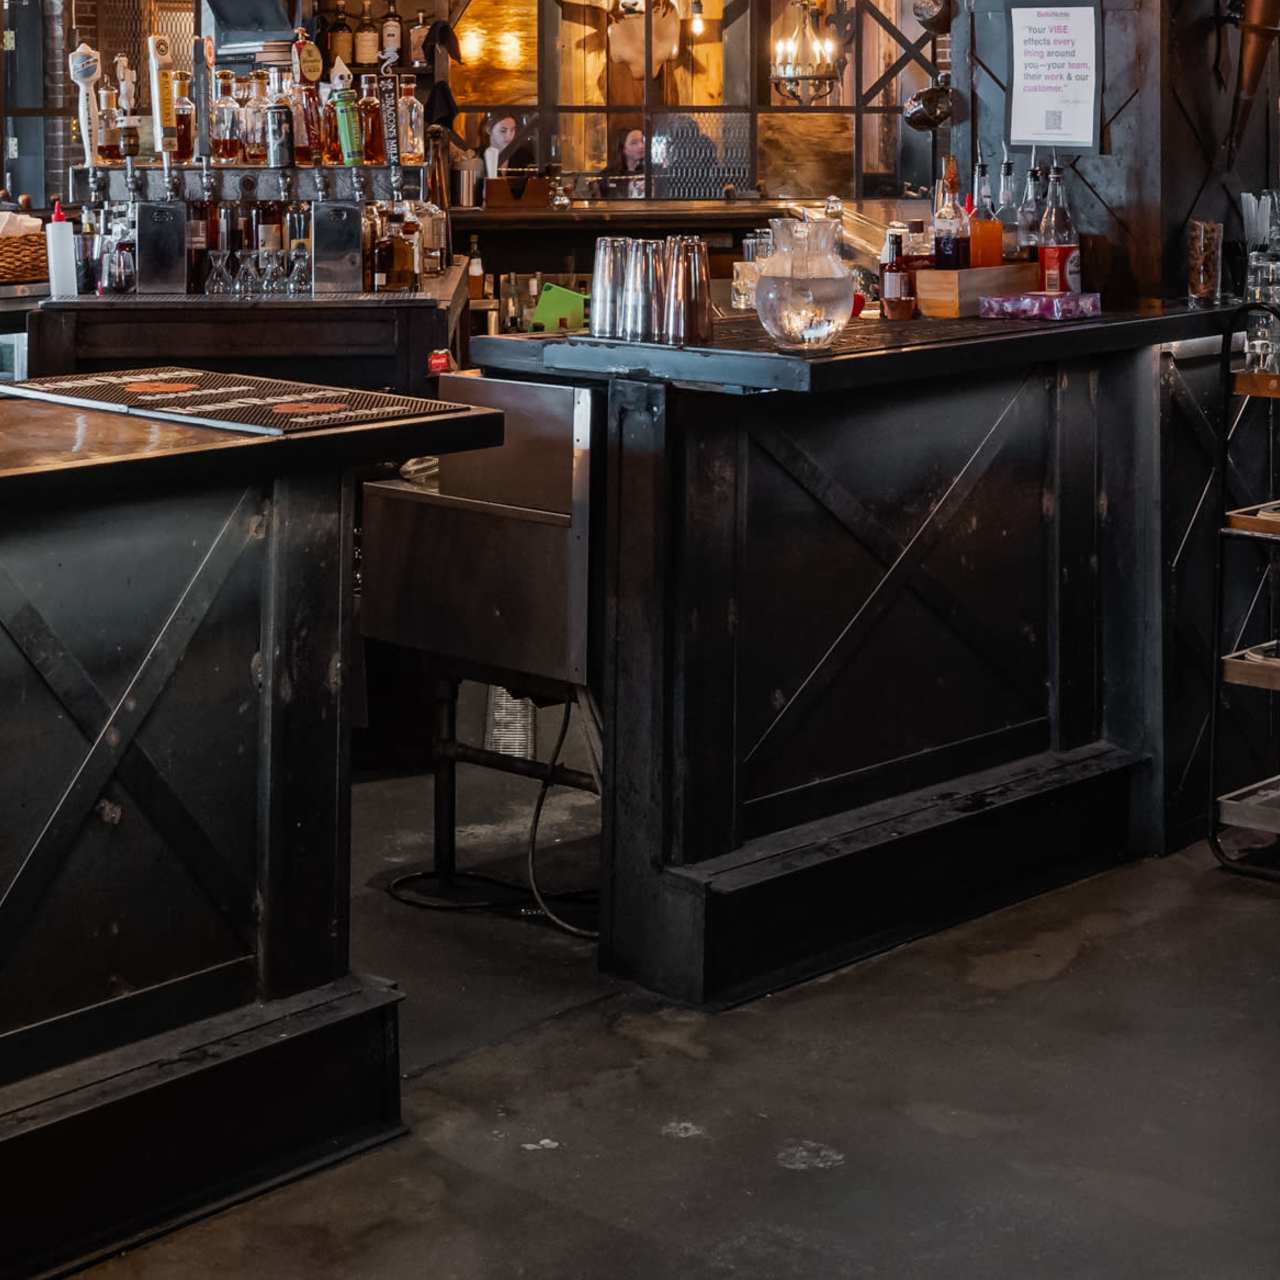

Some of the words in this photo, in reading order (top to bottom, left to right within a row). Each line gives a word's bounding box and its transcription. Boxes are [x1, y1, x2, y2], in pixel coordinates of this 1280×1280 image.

[1048, 25, 1069, 34] VIBE
[1023, 37, 1051, 46] effects
[1053, 39, 1075, 48] every
[1047, 49, 1076, 57] around
[1023, 72, 1042, 80] their
[1044, 72, 1064, 80] work
[1066, 72, 1073, 80] &
[1075, 73, 1089, 81] our
[389, 139, 399, 163] MILK
